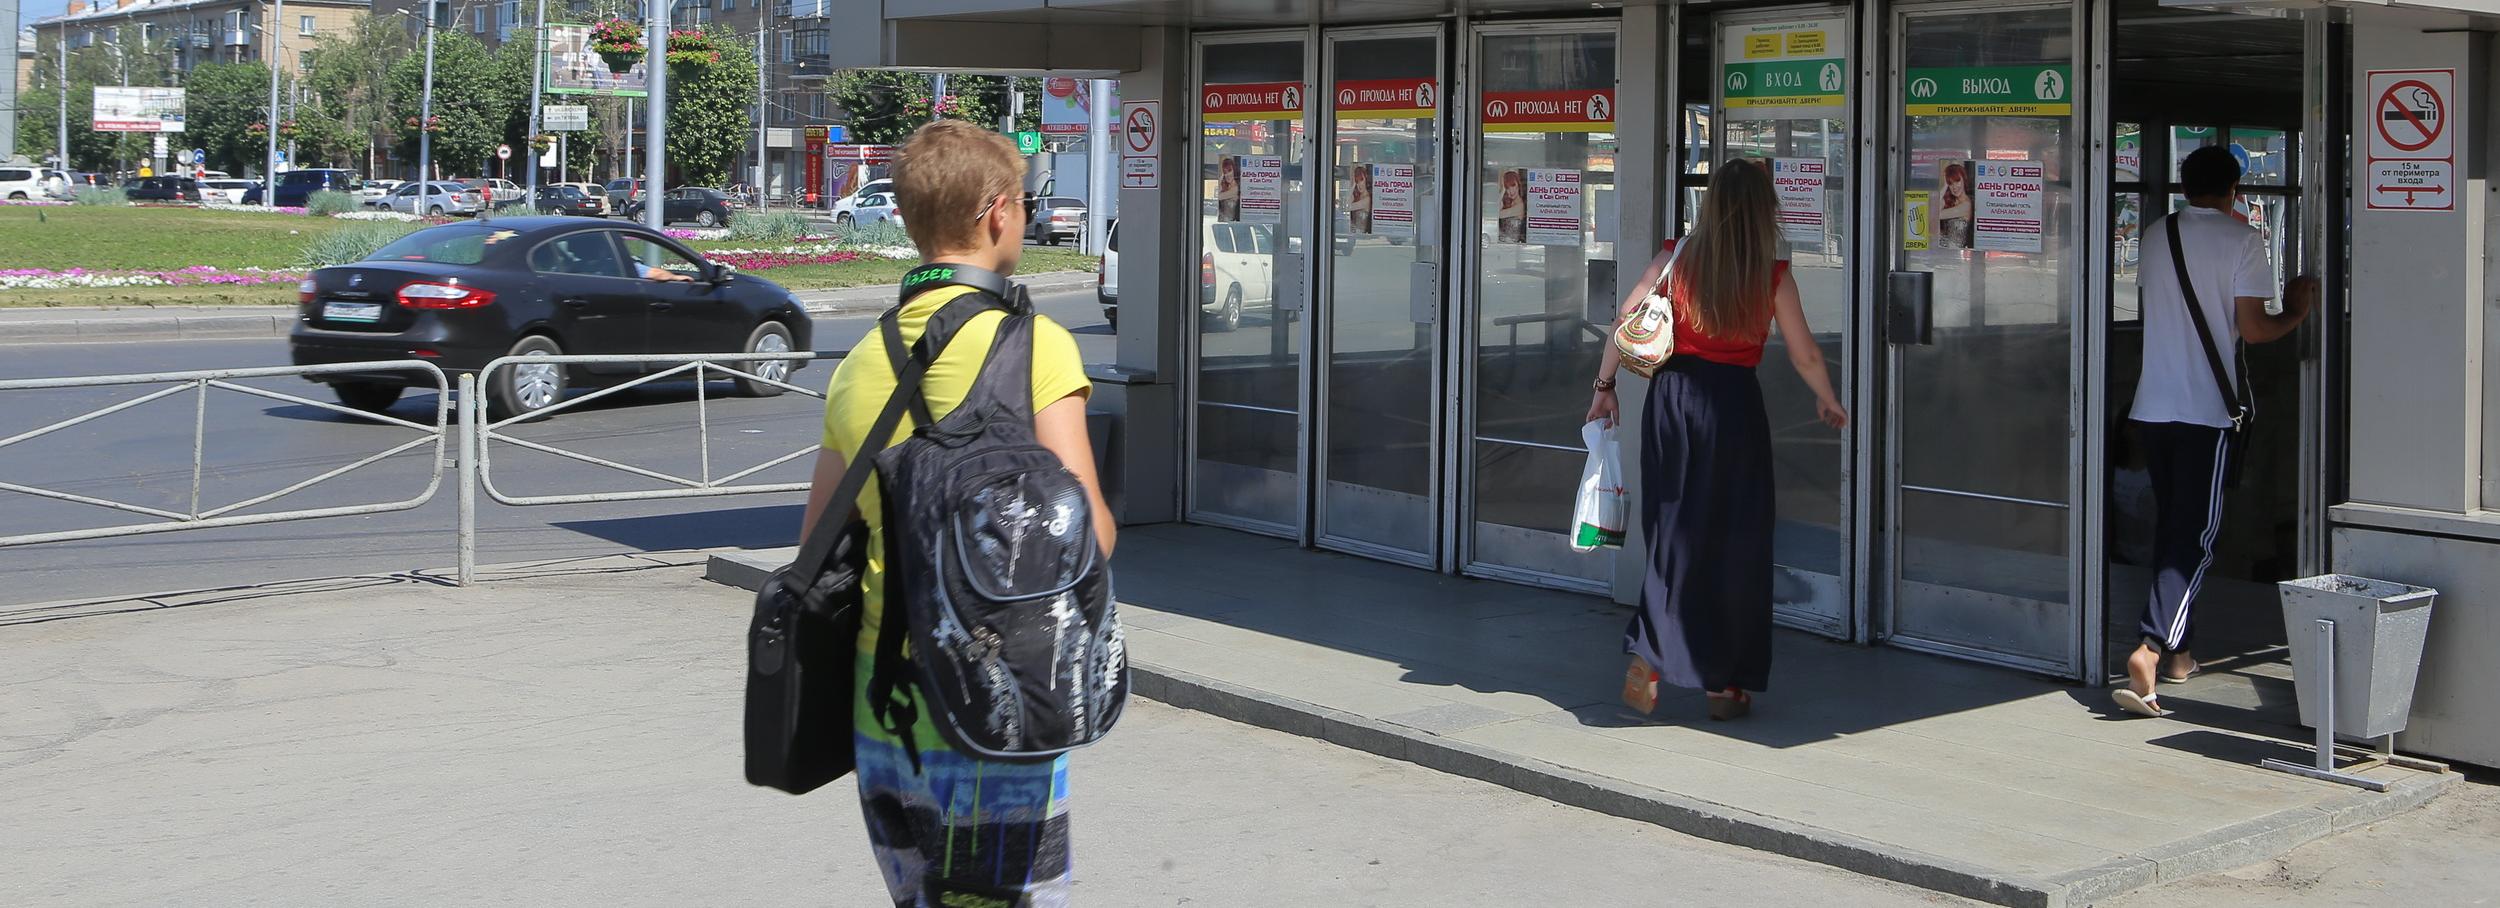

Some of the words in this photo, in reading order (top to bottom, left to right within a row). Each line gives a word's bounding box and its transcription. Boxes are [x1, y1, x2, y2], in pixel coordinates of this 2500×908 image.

[1766, 71, 1802, 87] ВХОД
[1962, 78, 2011, 94] ВЫХОД
[1227, 93, 1262, 105] ПРОХОДА
[1265, 92, 1279, 104] НЕТ
[1360, 89, 1396, 102] ПРОХОДА
[1399, 88, 1413, 101] НЕТ
[1514, 101, 1560, 114] ПРОХОДА
[1564, 100, 1582, 113] НЕТ
[2004, 183, 2040, 192] ГОРОДА
